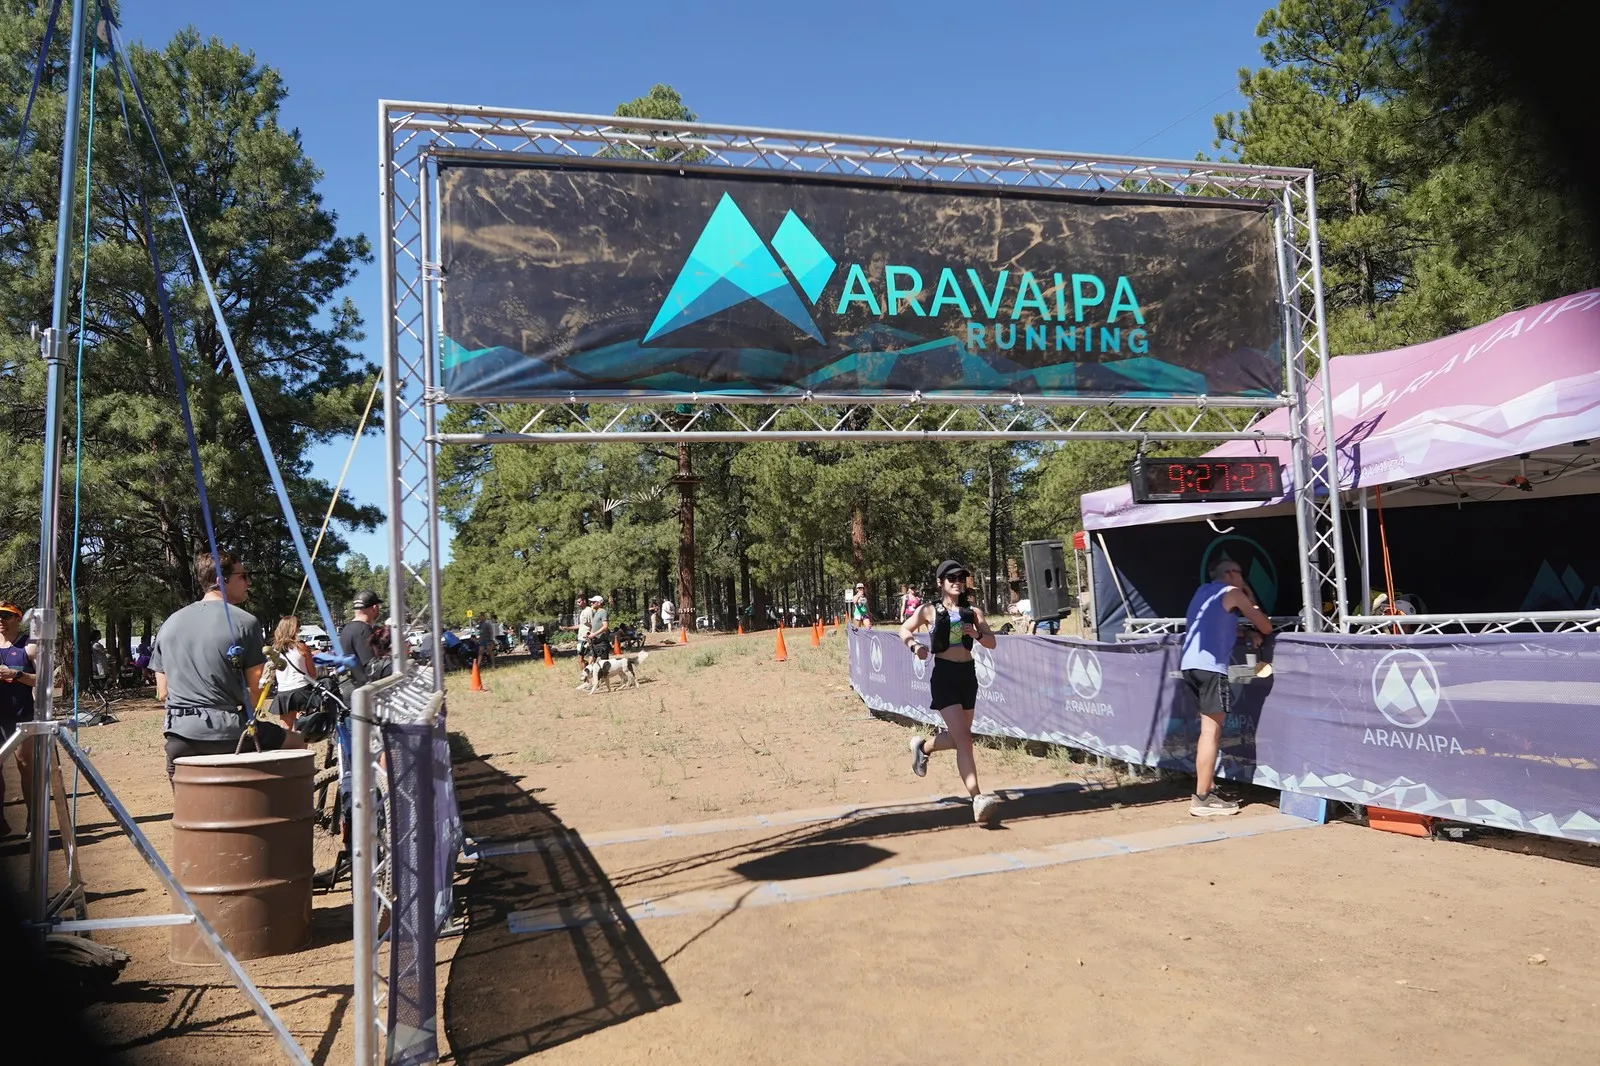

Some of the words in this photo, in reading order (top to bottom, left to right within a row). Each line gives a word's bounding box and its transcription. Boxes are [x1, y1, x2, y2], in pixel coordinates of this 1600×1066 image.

[836, 263, 1146, 325] ARAVAIPA
[966, 322, 1150, 354] RUNNING
[1358, 291, 1600, 418] ARAVAIP
[975, 688, 1007, 704] AVAIPA
[1065, 699, 1116, 718] ARAVAIPA
[1362, 727, 1466, 756] ARAVAIPA
